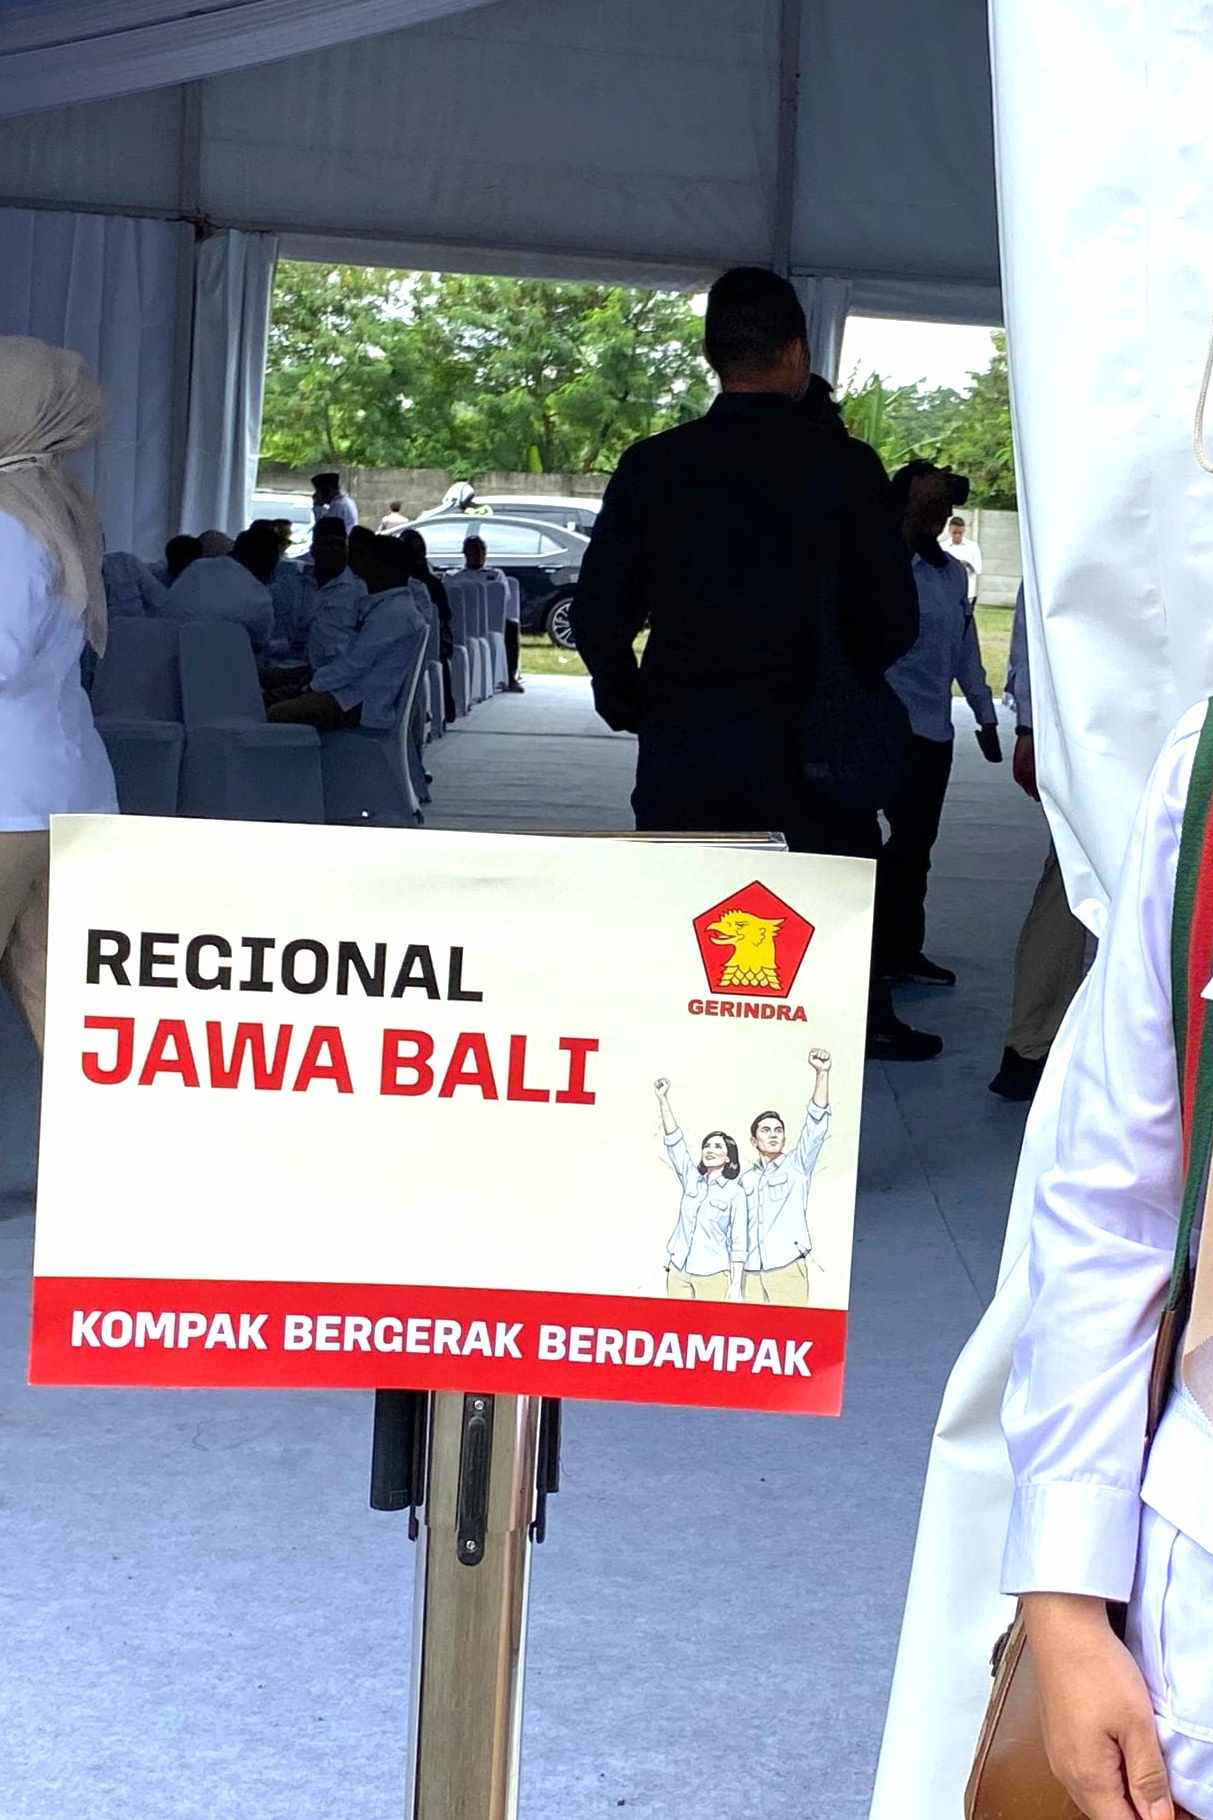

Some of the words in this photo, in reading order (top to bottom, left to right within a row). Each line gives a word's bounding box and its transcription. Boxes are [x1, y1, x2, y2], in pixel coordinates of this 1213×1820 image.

[86, 929, 484, 1002] REGIONAL
[687, 998, 809, 1023] GERINDRA
[81, 1015, 353, 1094] JAWA
[379, 1028, 599, 1105] BALI
[71, 1310, 268, 1350] KOMPAK
[283, 1314, 524, 1359] BERGERAK
[538, 1324, 813, 1377] BERDAMPAK
